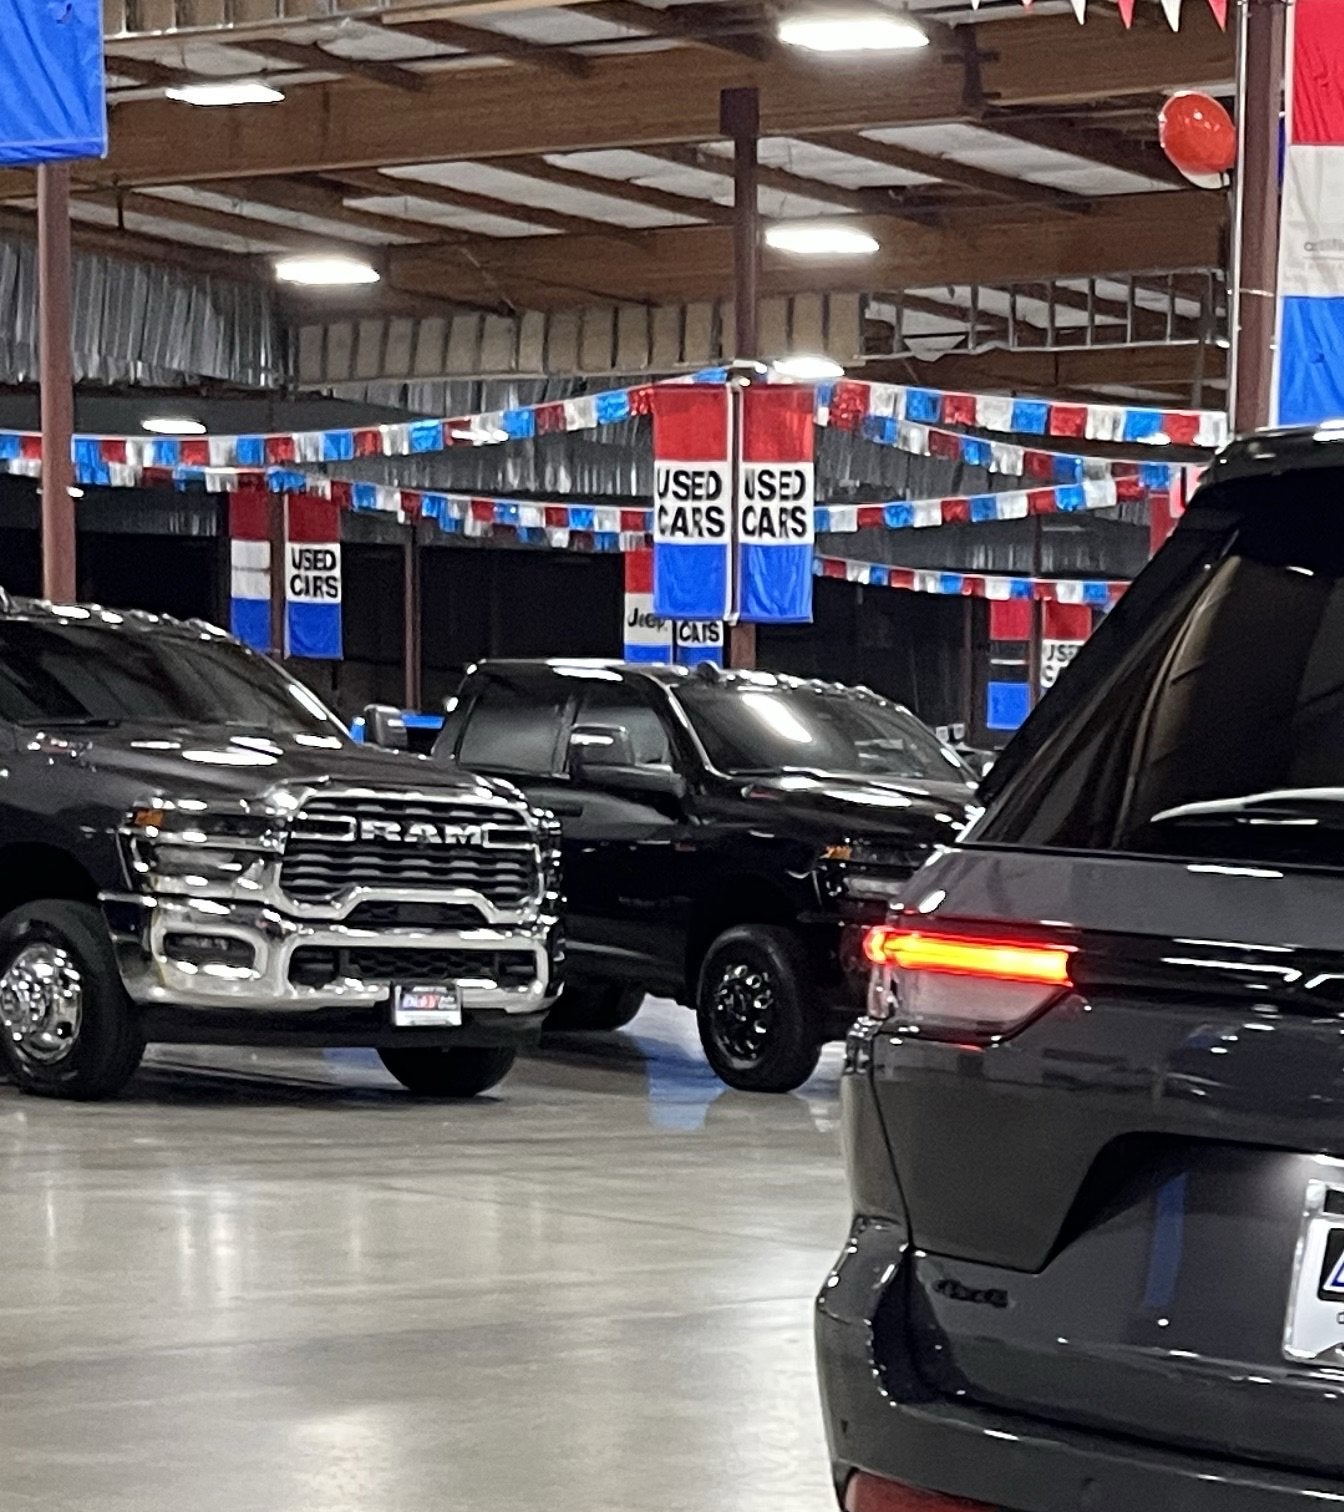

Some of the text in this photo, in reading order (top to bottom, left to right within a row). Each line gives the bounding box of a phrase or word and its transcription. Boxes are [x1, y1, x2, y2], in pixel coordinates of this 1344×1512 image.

[657, 468, 722, 501] USED
[744, 469, 806, 501] USED
[657, 505, 725, 538] CARS
[742, 505, 807, 538] CARS
[291, 547, 337, 571] USED
[361, 820, 482, 845] RAM
